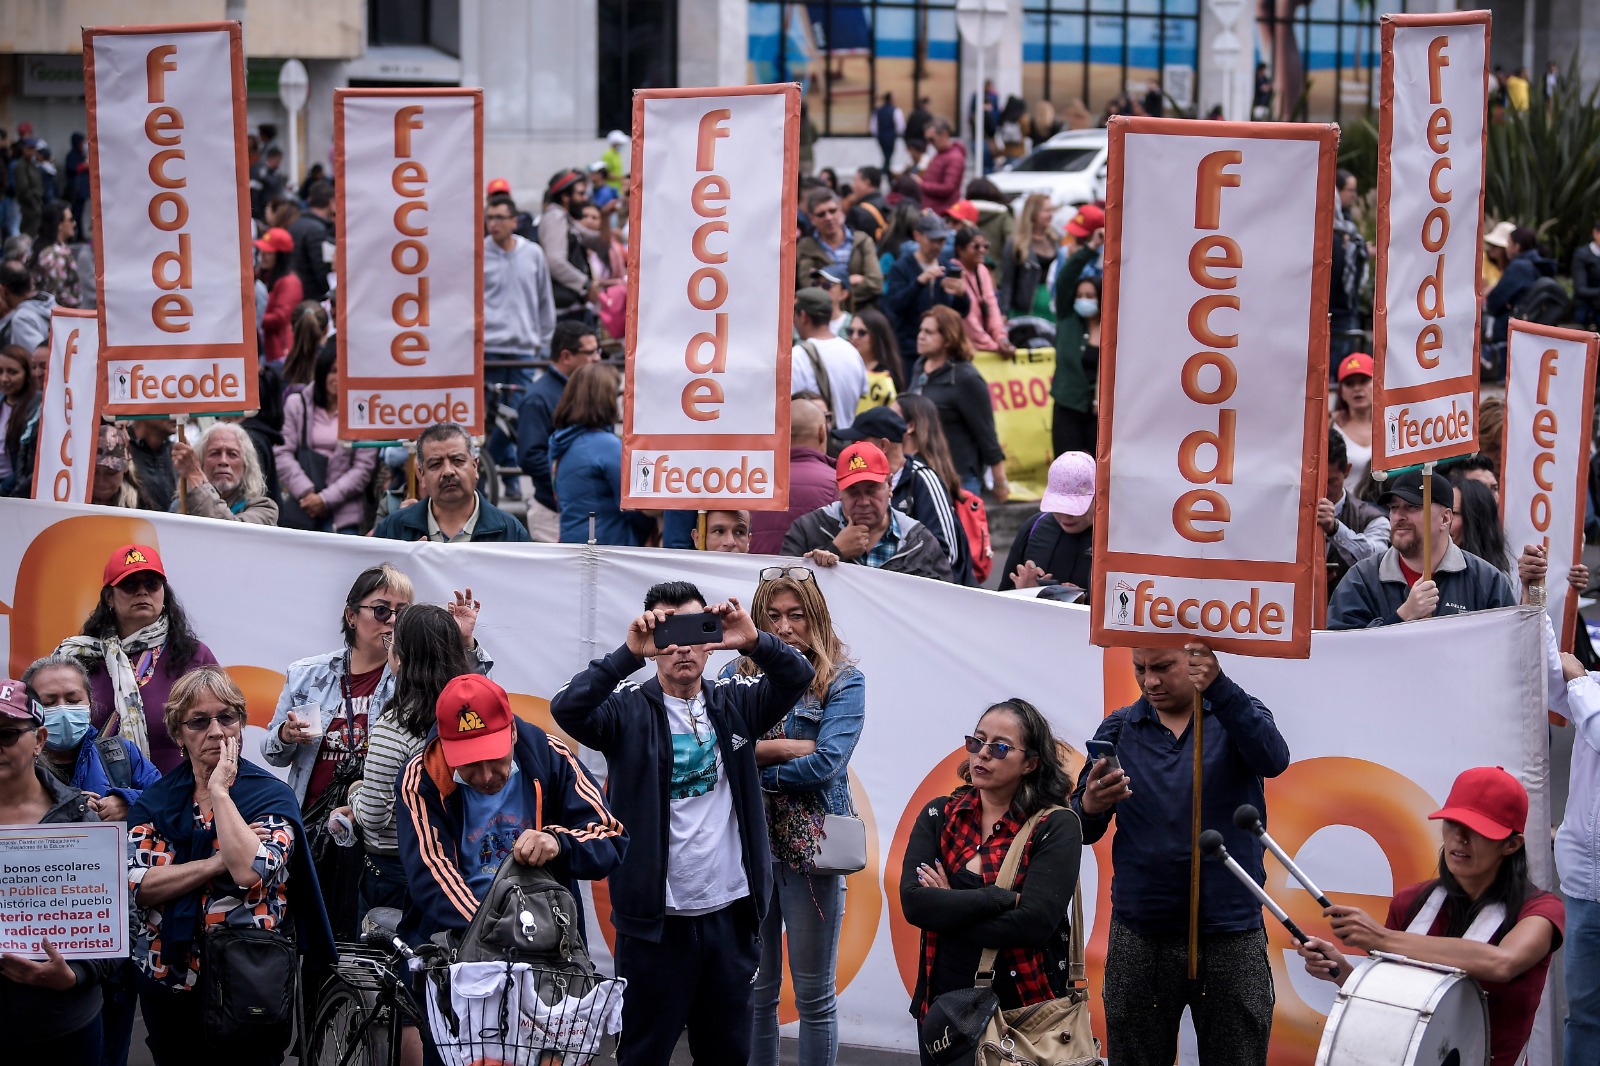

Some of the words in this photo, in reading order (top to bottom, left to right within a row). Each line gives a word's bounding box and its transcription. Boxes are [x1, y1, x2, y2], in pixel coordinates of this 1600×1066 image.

[144, 45, 193, 333] fecode
[1415, 36, 1453, 370] fecode
[390, 105, 430, 366] fecode
[681, 109, 732, 421] fecode
[1172, 150, 1243, 542] fecode
[130, 363, 239, 399] fecode
[53, 328, 79, 502] feco
[368, 392, 469, 425] fecode
[1398, 400, 1469, 449] fecode
[1530, 349, 1559, 548] feco
[653, 455, 768, 494] fecode
[1133, 580, 1286, 635] fecode
[0, 875, 38, 884] caban
[66, 873, 77, 882] la
[4, 864, 41, 873] bonos
[44, 862, 101, 872] escolares
[9, 885, 57, 897] Pública
[61, 883, 108, 895] Estatal,
[50, 897, 68, 907] del
[71, 896, 113, 908] pueblo
[0, 911, 34, 922] terio
[37, 910, 93, 921] rechaza
[97, 908, 110, 919] el
[4, 925, 67, 936] radicado
[70, 925, 94, 937] por
[98, 923, 111, 934] la
[31, 937, 114, 952] gerrerista!
